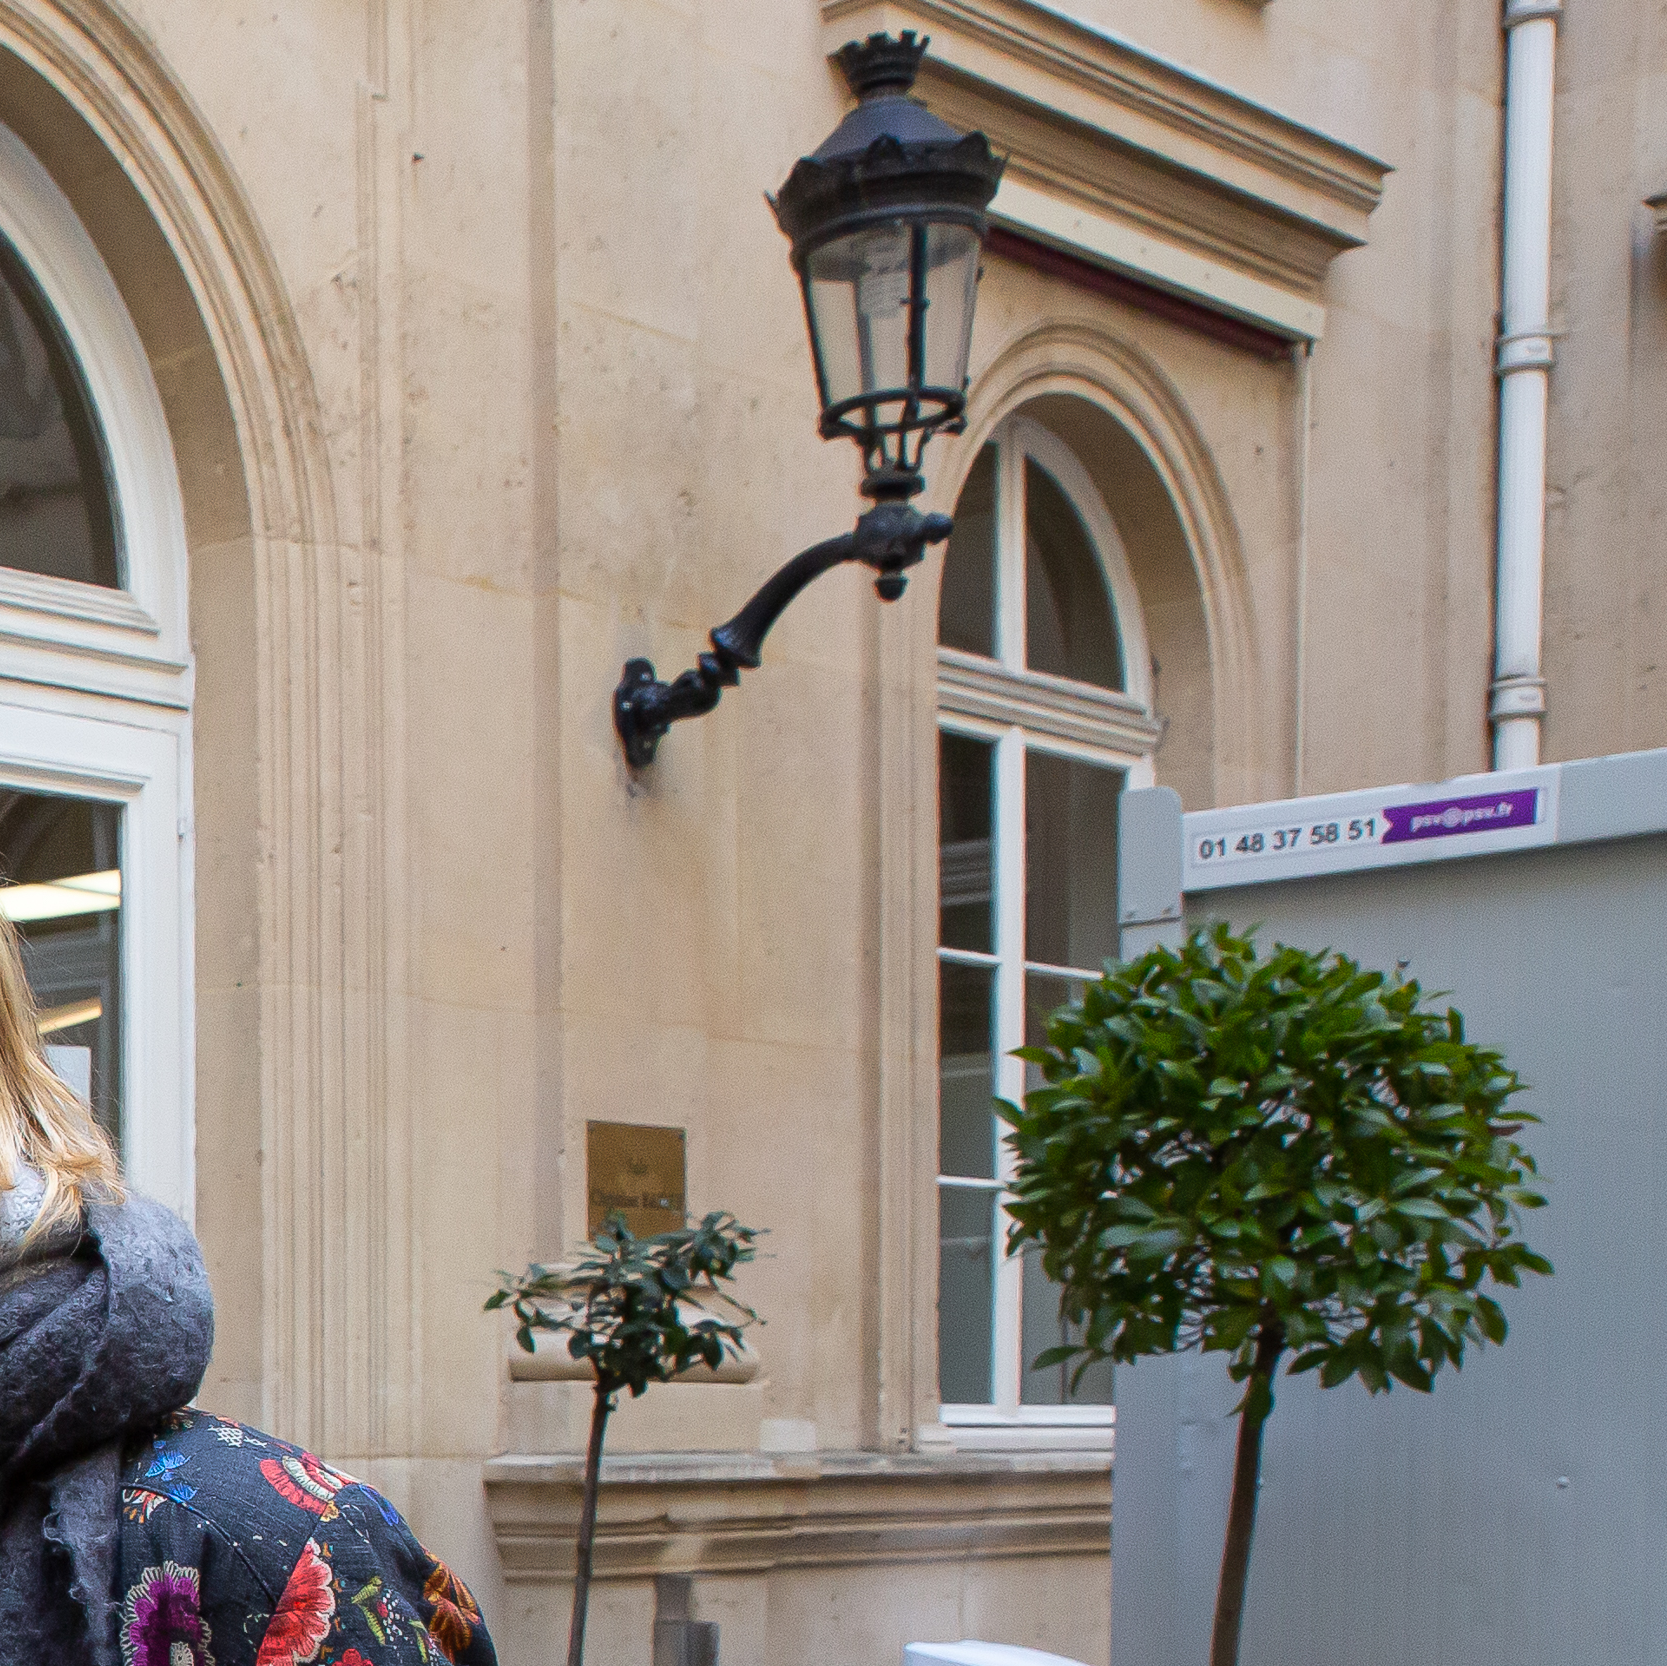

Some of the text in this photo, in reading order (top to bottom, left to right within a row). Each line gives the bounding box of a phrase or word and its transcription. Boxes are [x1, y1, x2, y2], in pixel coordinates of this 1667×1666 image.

[1199, 817, 1375, 860] 01 48 37 58 51
